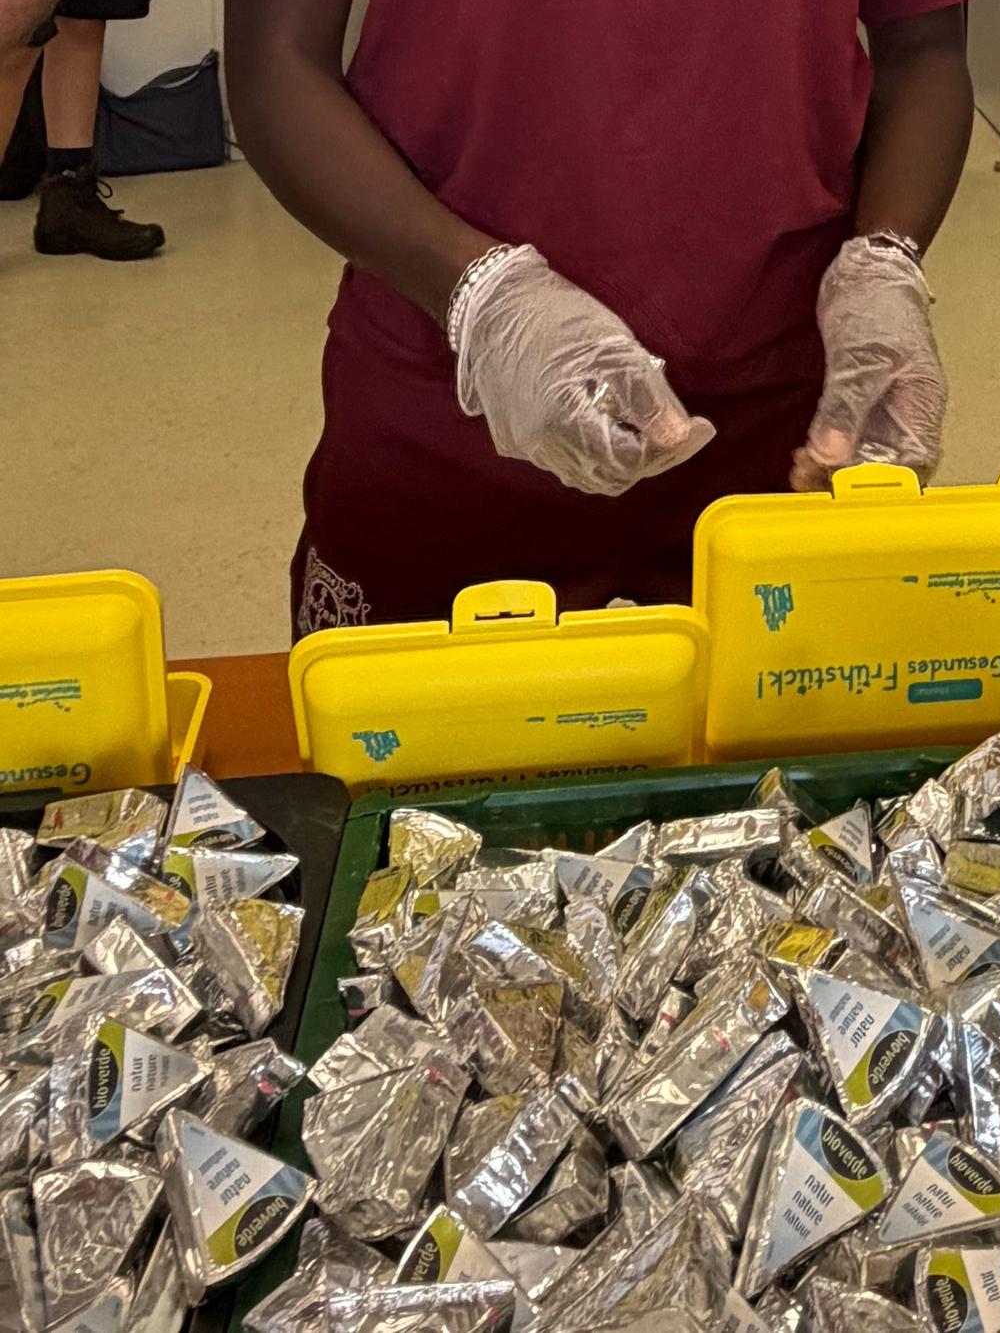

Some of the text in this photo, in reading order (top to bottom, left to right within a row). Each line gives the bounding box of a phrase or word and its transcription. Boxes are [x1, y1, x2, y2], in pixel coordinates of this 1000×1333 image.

[757, 662, 898, 700] Frühstück!
[838, 1001, 864, 1036] nature
[850, 1014, 875, 1048] natur
[131, 1057, 142, 1092] natur
[869, 1032, 911, 1085] bioverde
[93, 1046, 111, 1110] bioverde
[822, 1125, 868, 1180] bioverde
[220, 1173, 251, 1205] natur
[804, 1174, 835, 1207] natur
[950, 1151, 993, 1195] bioverde
[792, 1190, 824, 1226] nature
[912, 1191, 943, 1219] nature
[926, 1183, 957, 1209] natur
[235, 1195, 290, 1248] bioverde
[783, 1208, 812, 1239] natuur
[934, 1277, 962, 1333] bioverde
